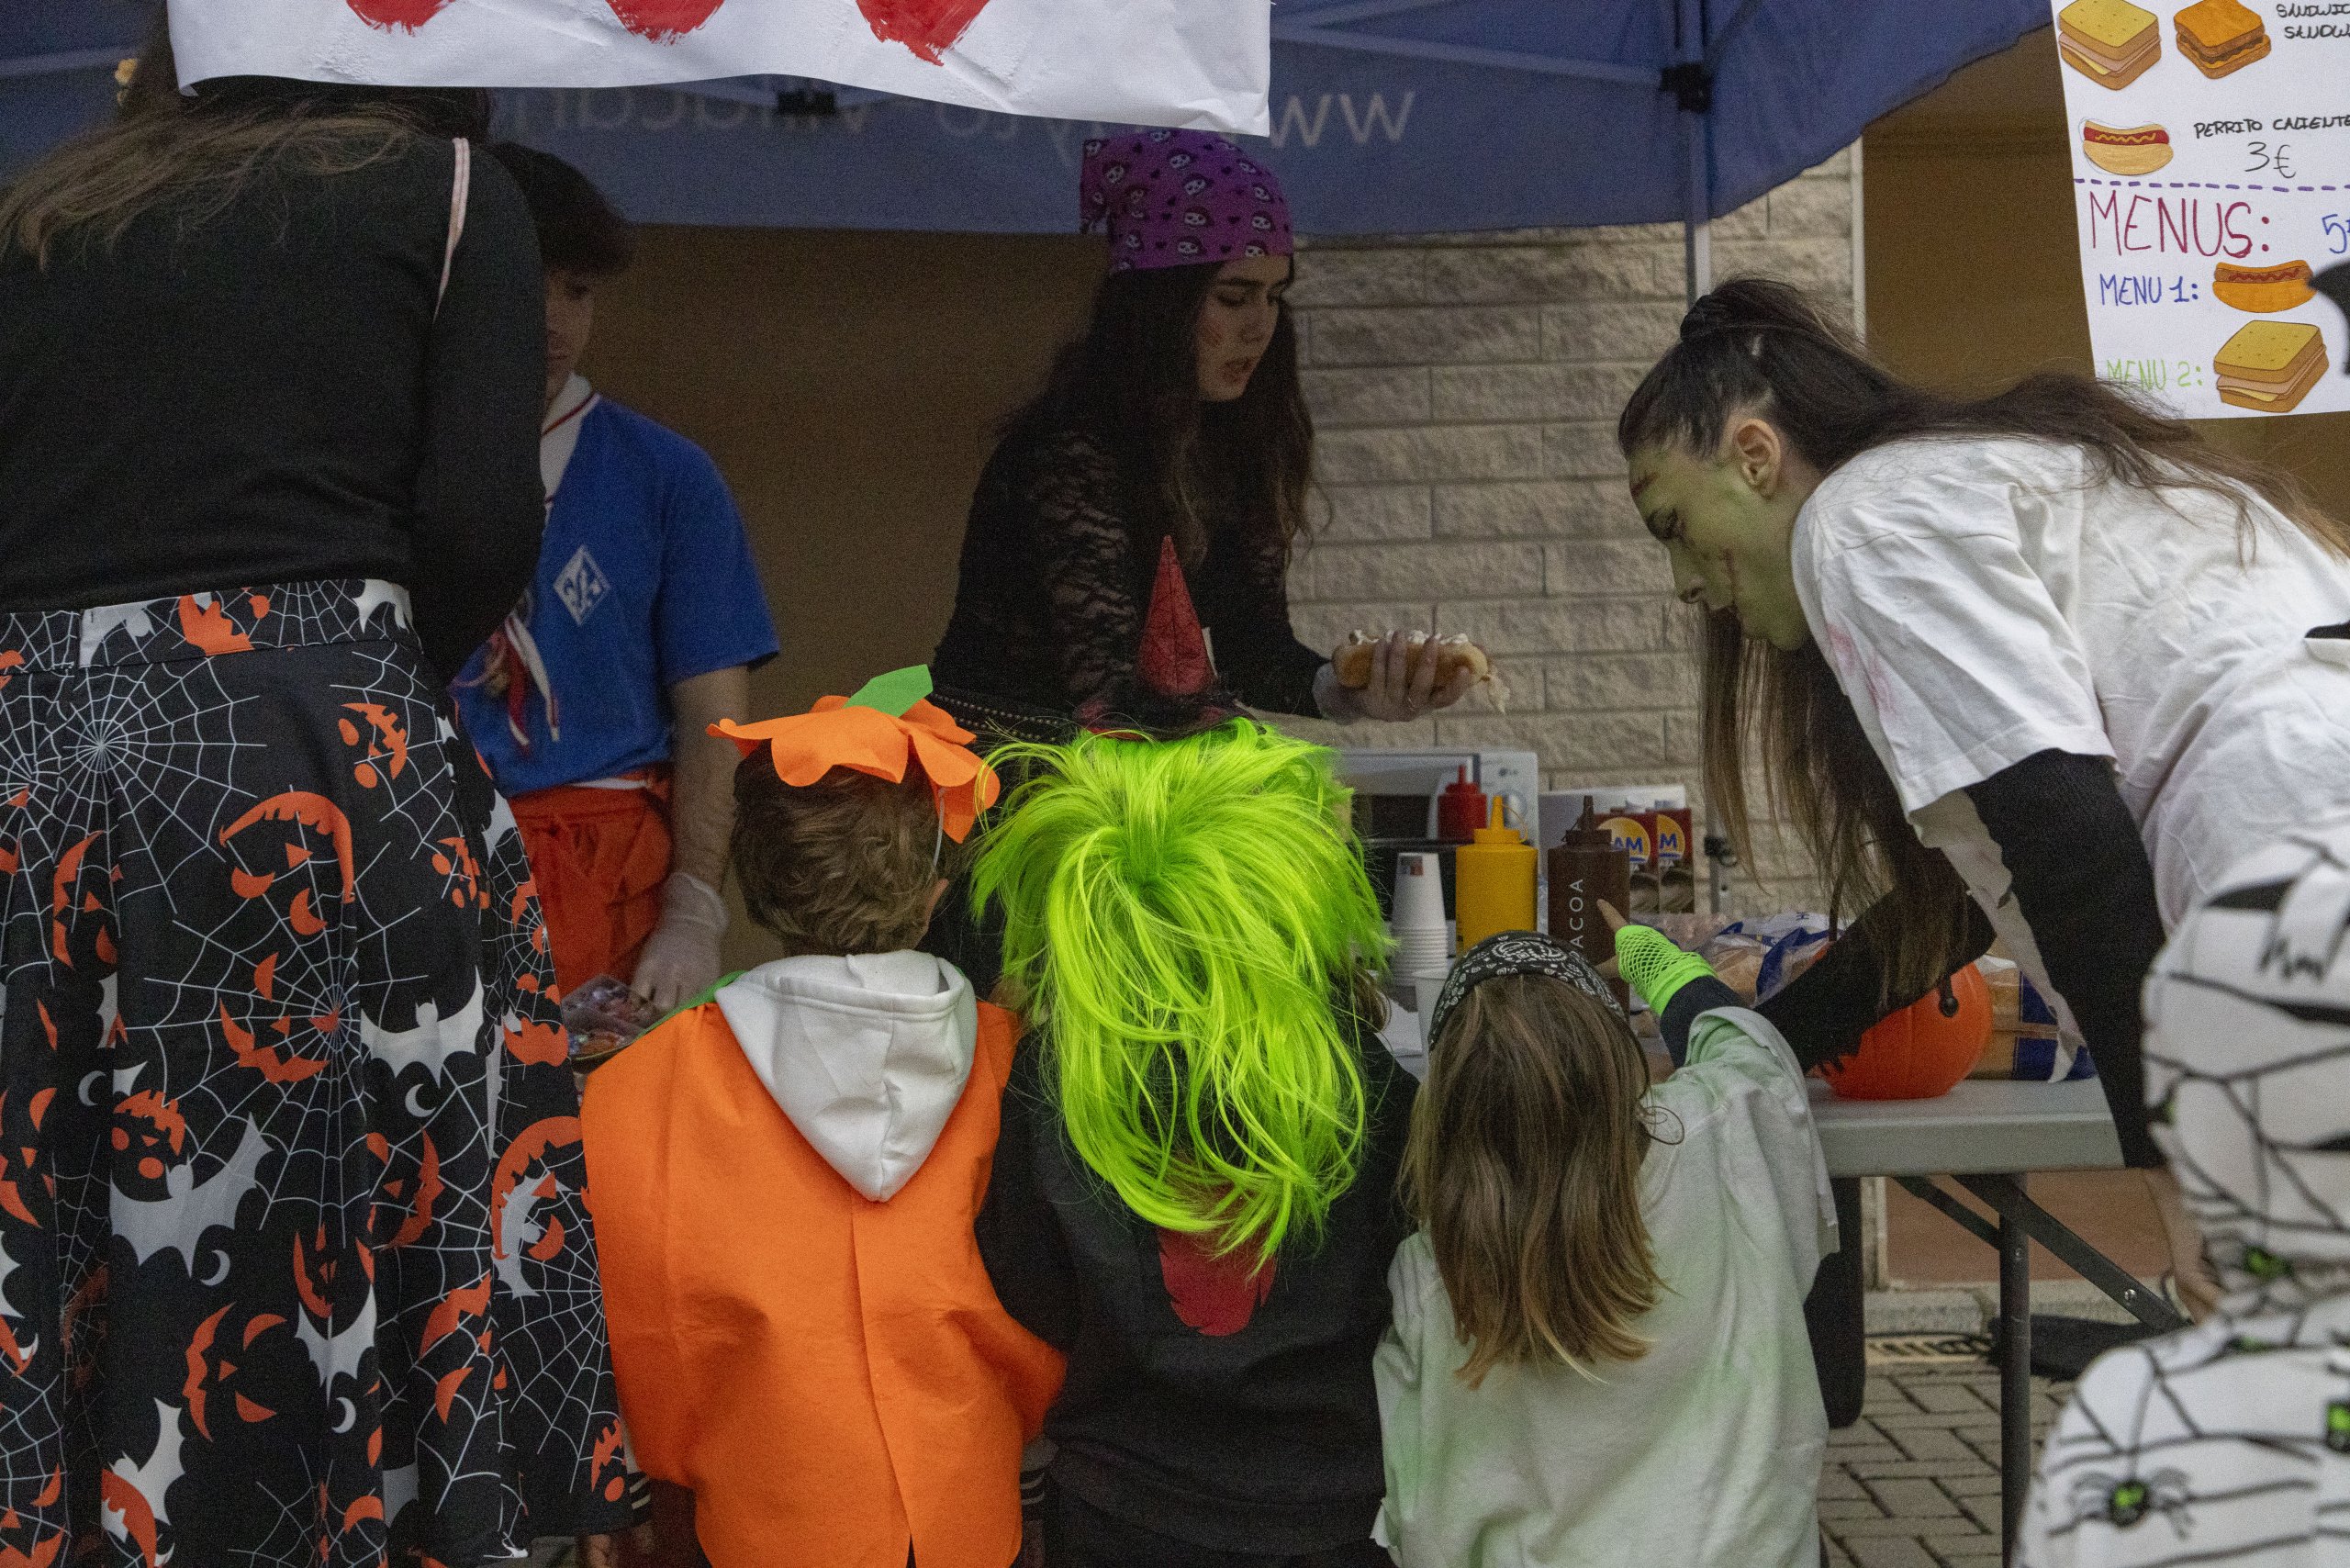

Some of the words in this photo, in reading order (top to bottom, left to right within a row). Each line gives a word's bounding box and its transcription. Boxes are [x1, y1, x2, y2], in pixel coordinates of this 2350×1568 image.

[2276, 3, 2350, 18] SANDWIC
[2284, 23, 2350, 39] SANDW
[2194, 118, 2263, 139] PERRITO
[2244, 141, 2297, 179] 3€
[2088, 189, 2270, 258] MENUS:
[2322, 213, 2350, 254] 5
[2099, 273, 2163, 307] MENU
[2169, 276, 2199, 303] 1:
[2106, 358, 2167, 391] MENU
[2177, 361, 2203, 386] 2:
[1610, 836, 1644, 853] AM
[1569, 879, 1583, 949] ACOA
